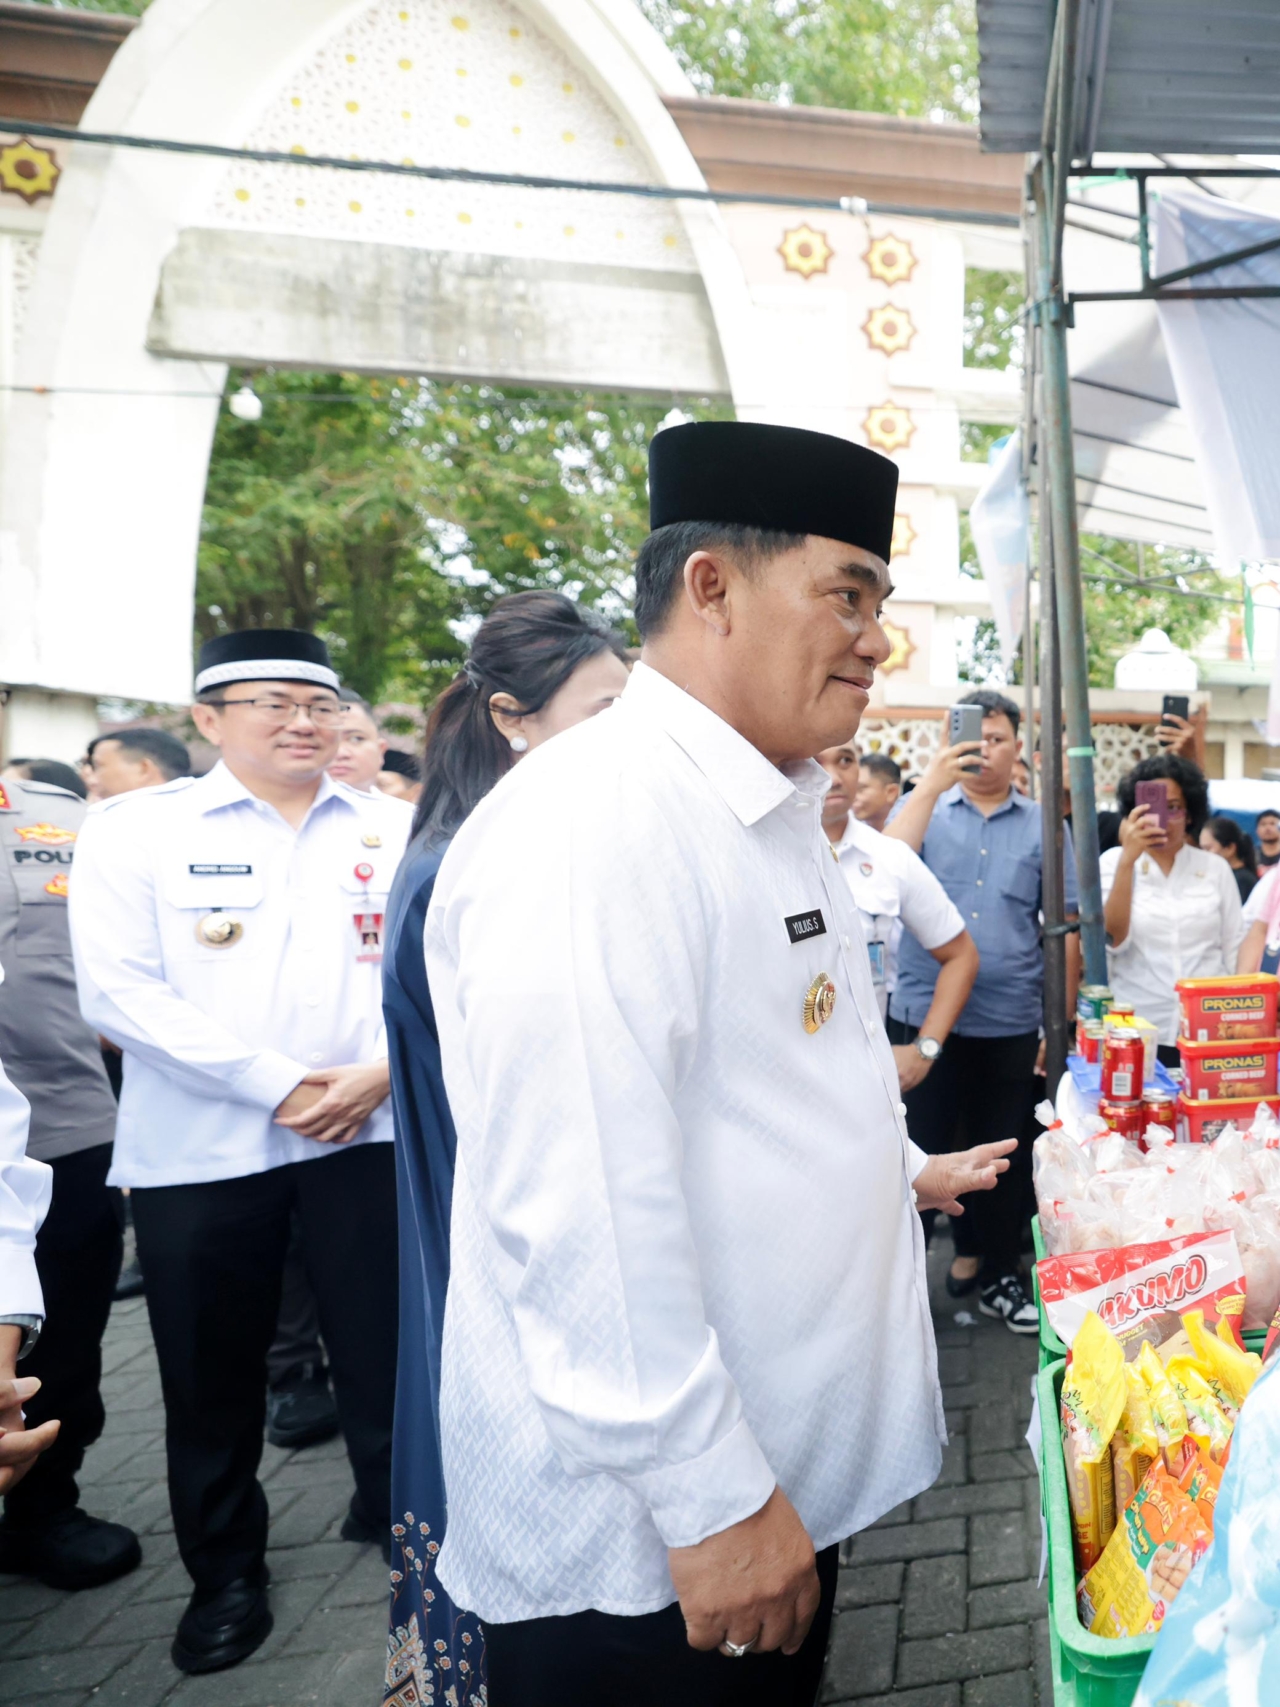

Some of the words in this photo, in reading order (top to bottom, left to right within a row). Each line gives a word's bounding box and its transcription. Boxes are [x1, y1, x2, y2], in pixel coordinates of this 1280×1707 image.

[1203, 997, 1263, 1011] PRONAS
[1203, 1056, 1263, 1070] PRONAS
[1097, 1254, 1207, 1329] AKUMO
